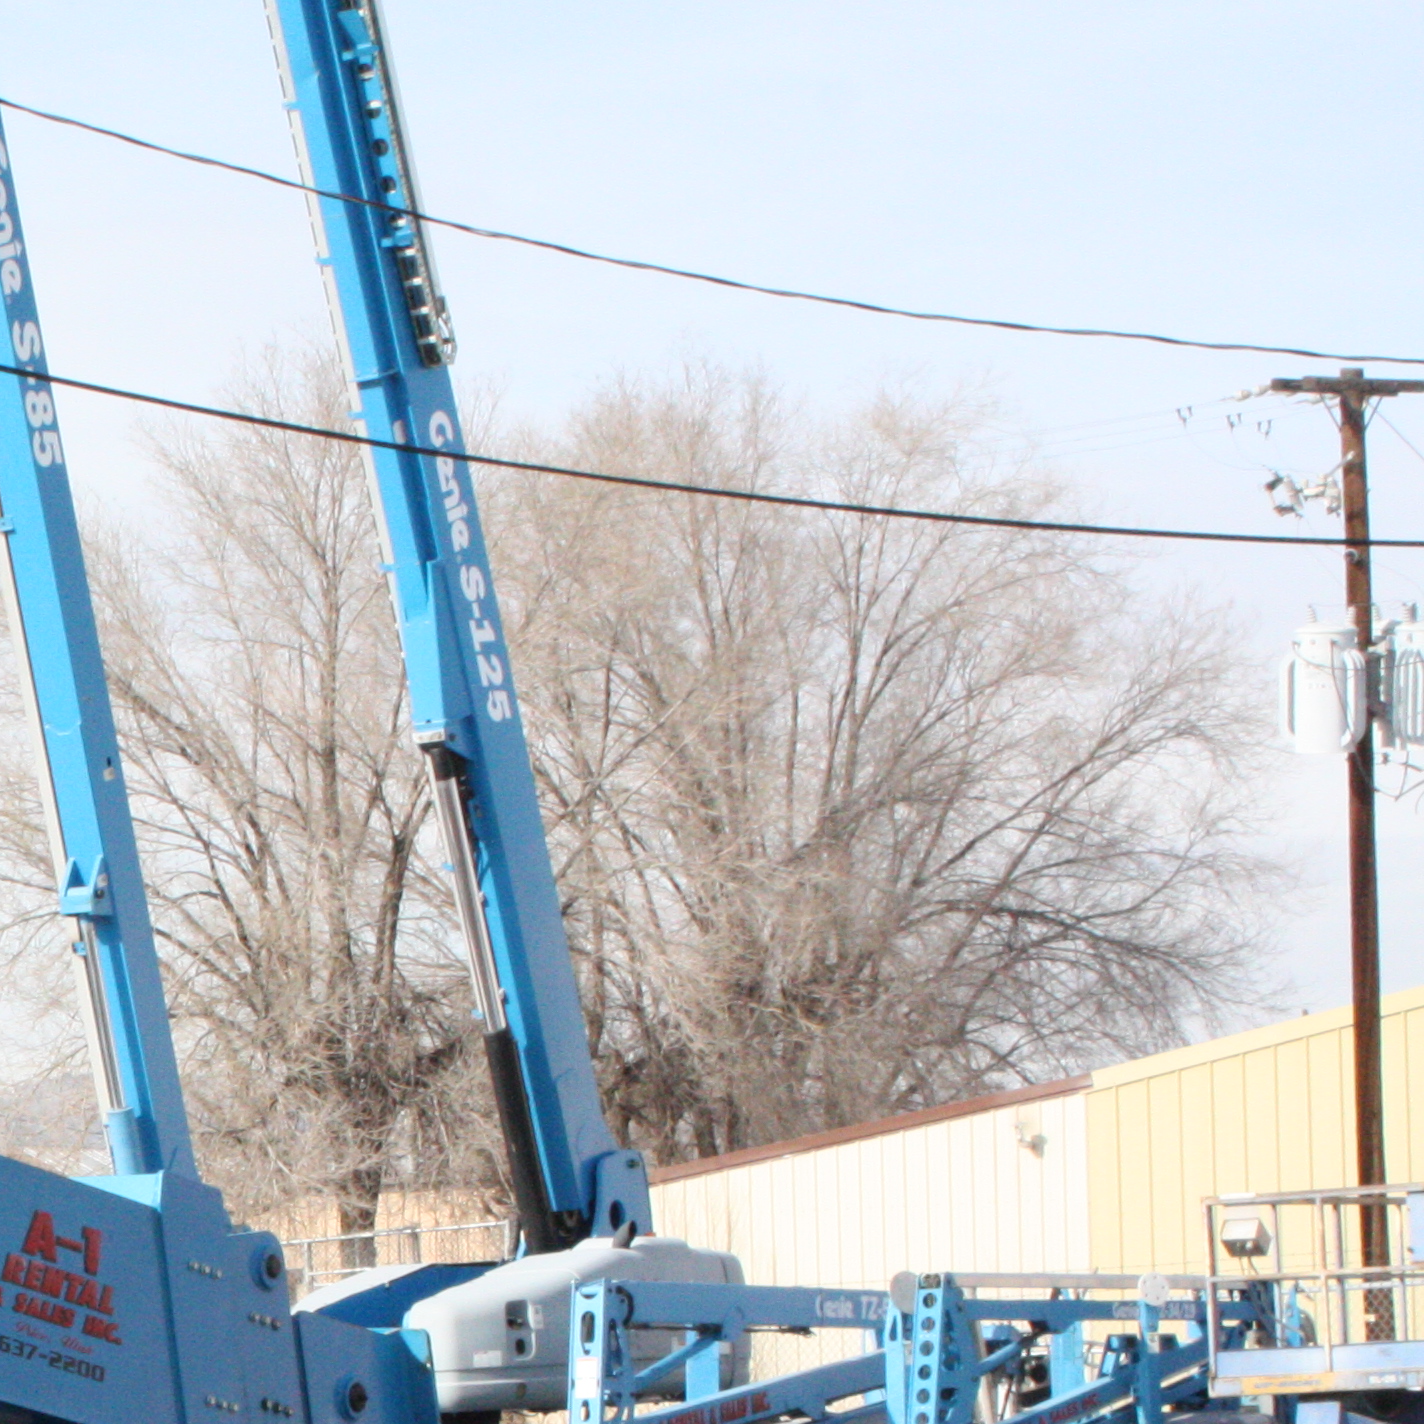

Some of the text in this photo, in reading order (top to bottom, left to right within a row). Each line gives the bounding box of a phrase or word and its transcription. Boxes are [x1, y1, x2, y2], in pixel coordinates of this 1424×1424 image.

[13, 320, 63, 467] S-85
[429, 410, 511, 722] Genie S-125
[21, 1209, 103, 1276] A-1
[0, 1252, 115, 1316] RENTAL
[13, 1292, 76, 1329] SALES
[1049, 1401, 1078, 1421] SALES
